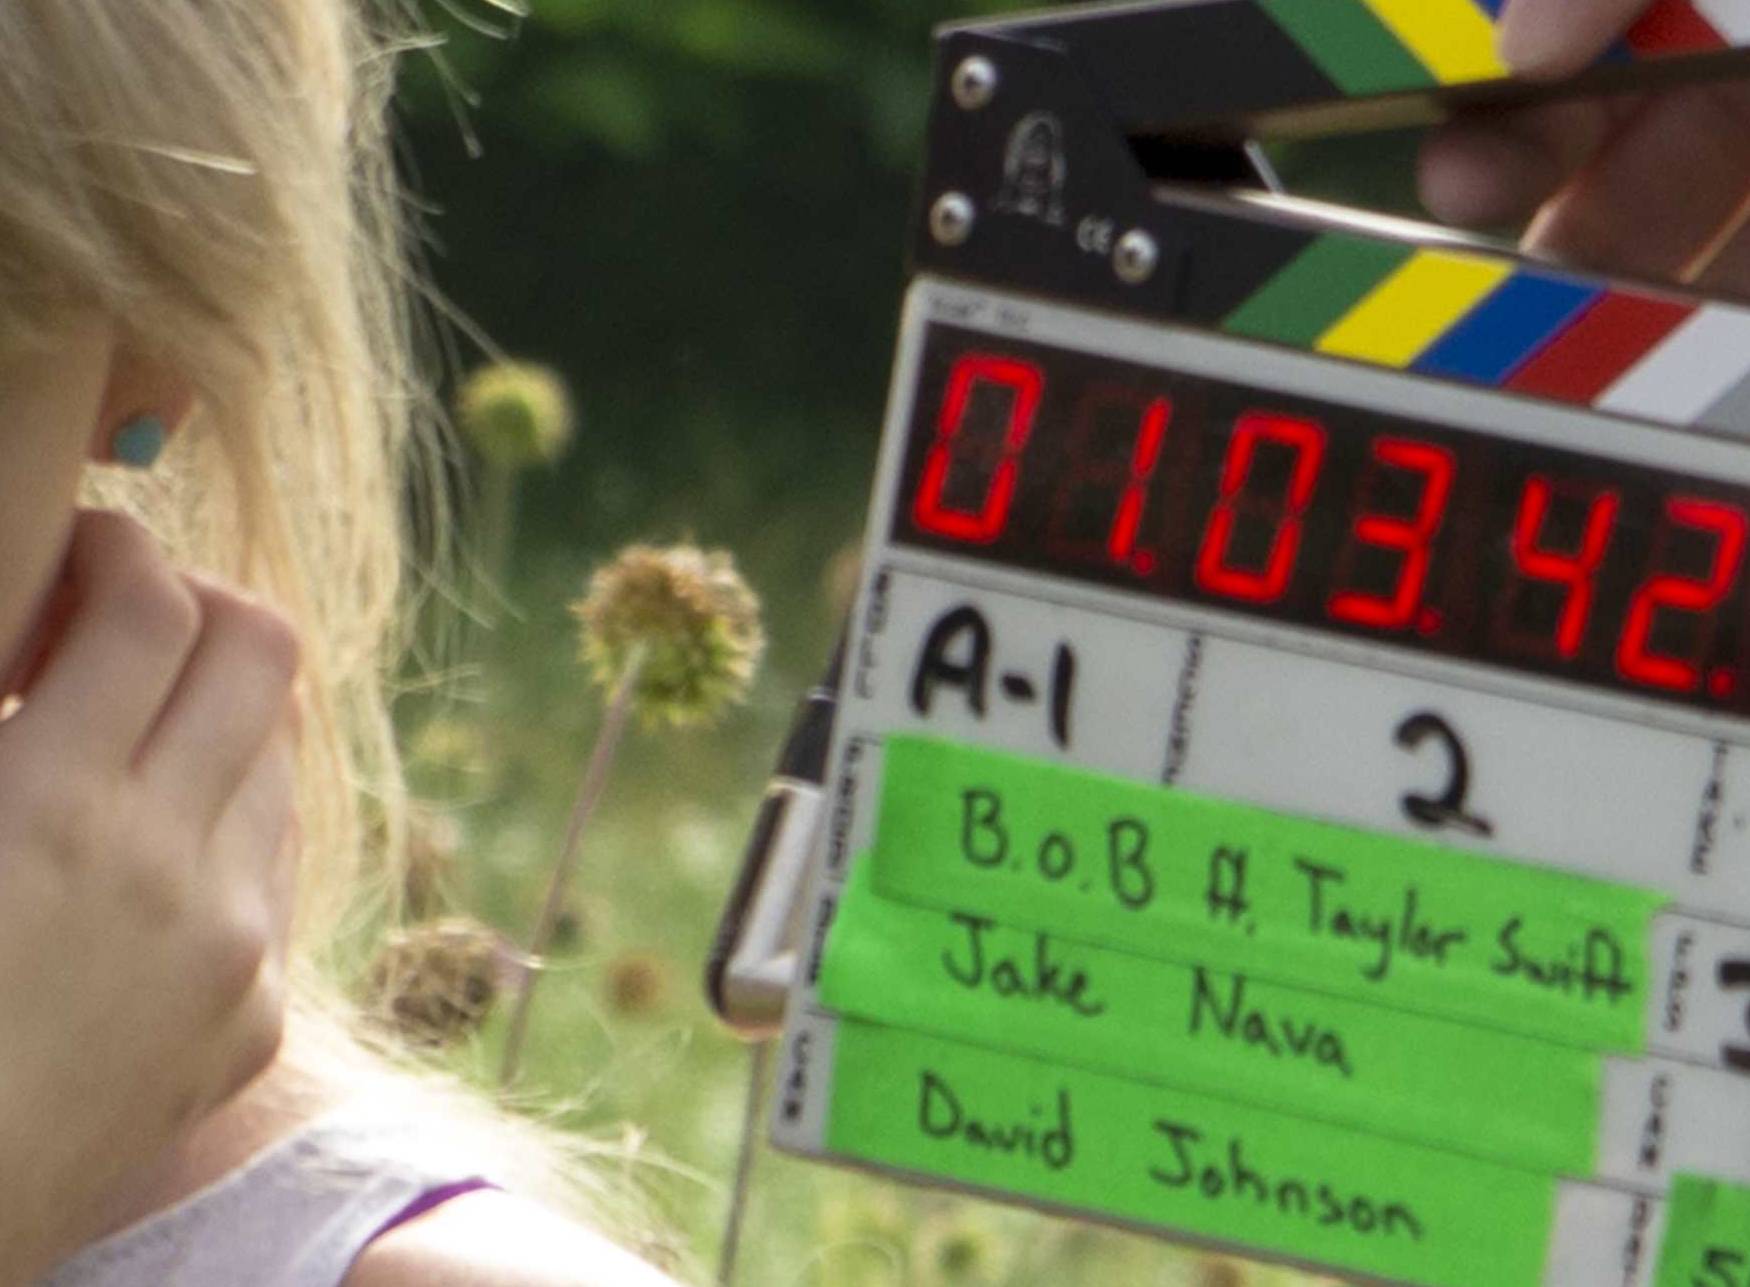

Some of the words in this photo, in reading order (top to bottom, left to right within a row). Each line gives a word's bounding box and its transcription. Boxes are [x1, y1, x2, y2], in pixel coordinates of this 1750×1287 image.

[910, 605, 1074, 751] A-1
[1394, 713, 1494, 839] 2
[942, 913, 1105, 1015] Jake
[1190, 966, 1353, 1077] Nava
[1293, 856, 1466, 982] Taylor
[1490, 917, 1632, 1005] Swift
[917, 1070, 1074, 1170] David
[1152, 1120, 1424, 1240] Johnson
